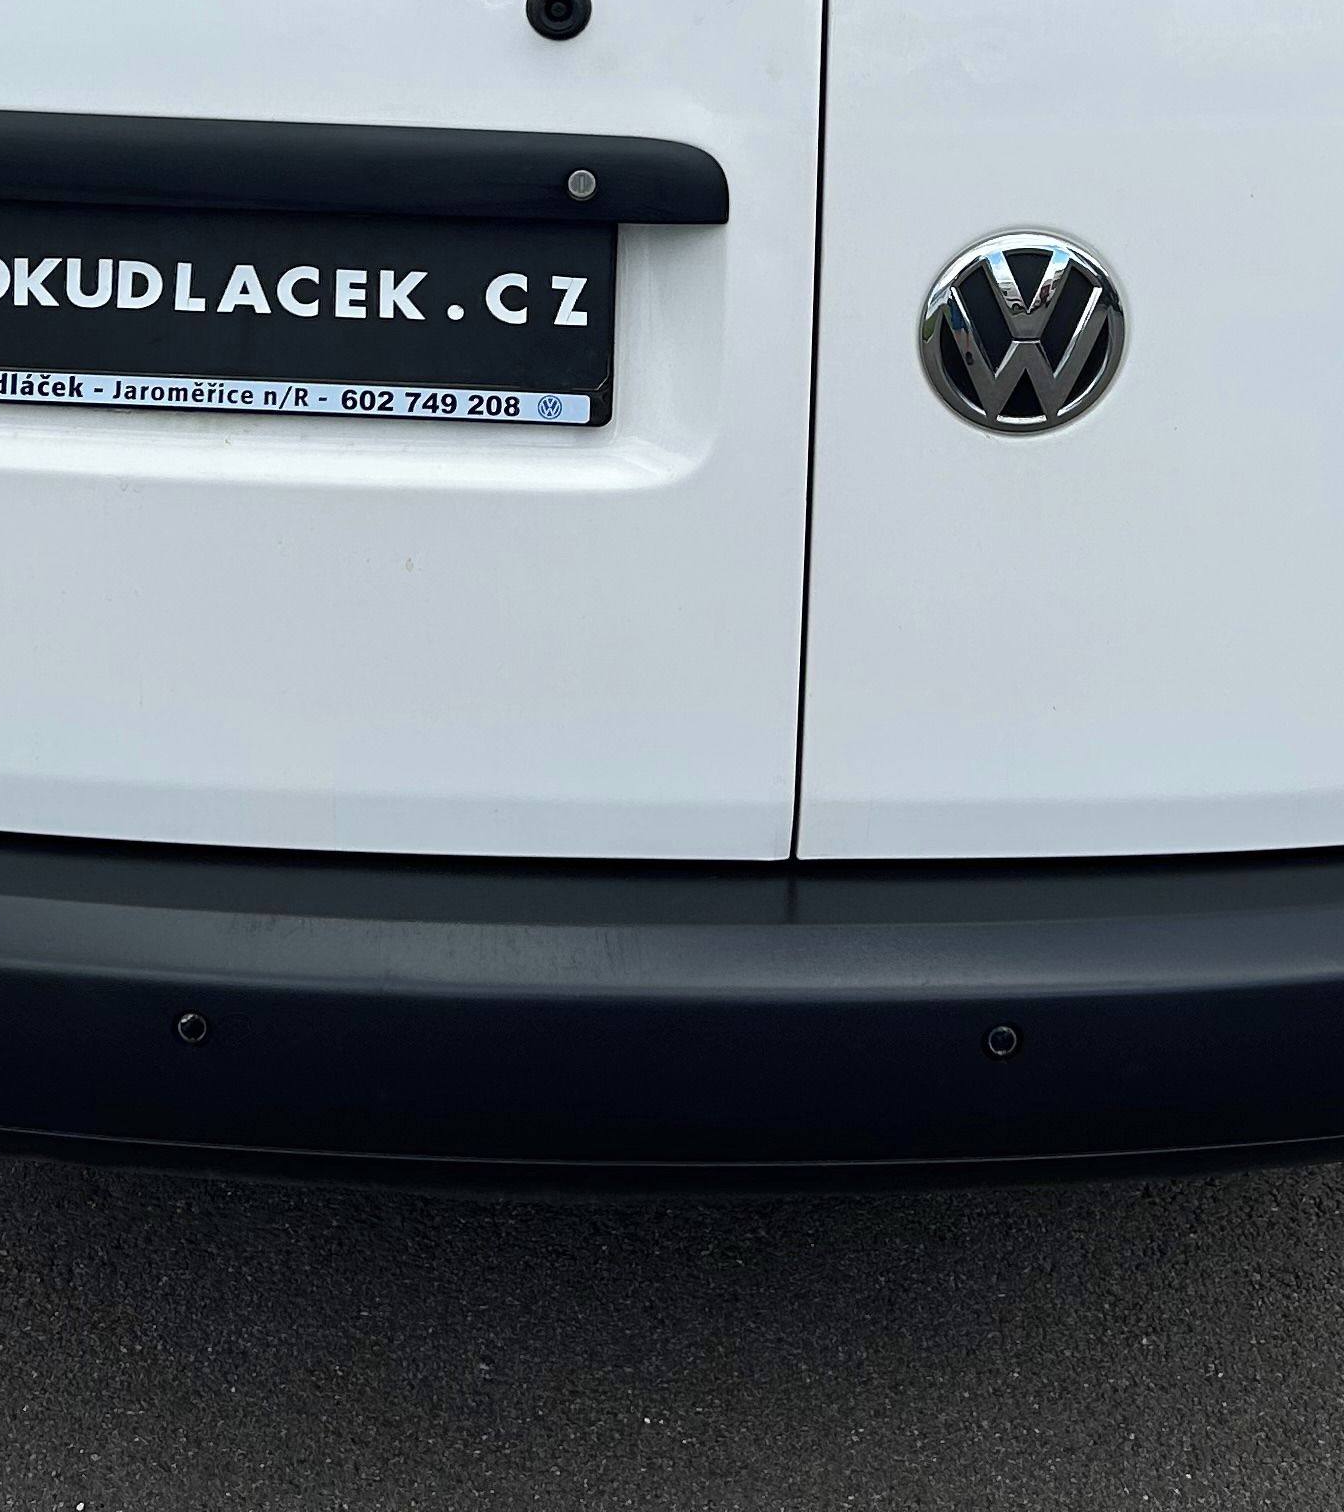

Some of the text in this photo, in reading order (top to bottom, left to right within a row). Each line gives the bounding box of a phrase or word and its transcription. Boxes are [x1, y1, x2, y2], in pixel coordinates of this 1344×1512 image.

[938, 243, 1114, 421] VW
[112, 380, 254, 405] Jaroměřice
[263, 385, 309, 410] n/R
[341, 389, 394, 412] 602
[404, 391, 458, 415] 749
[467, 394, 521, 417] 208
